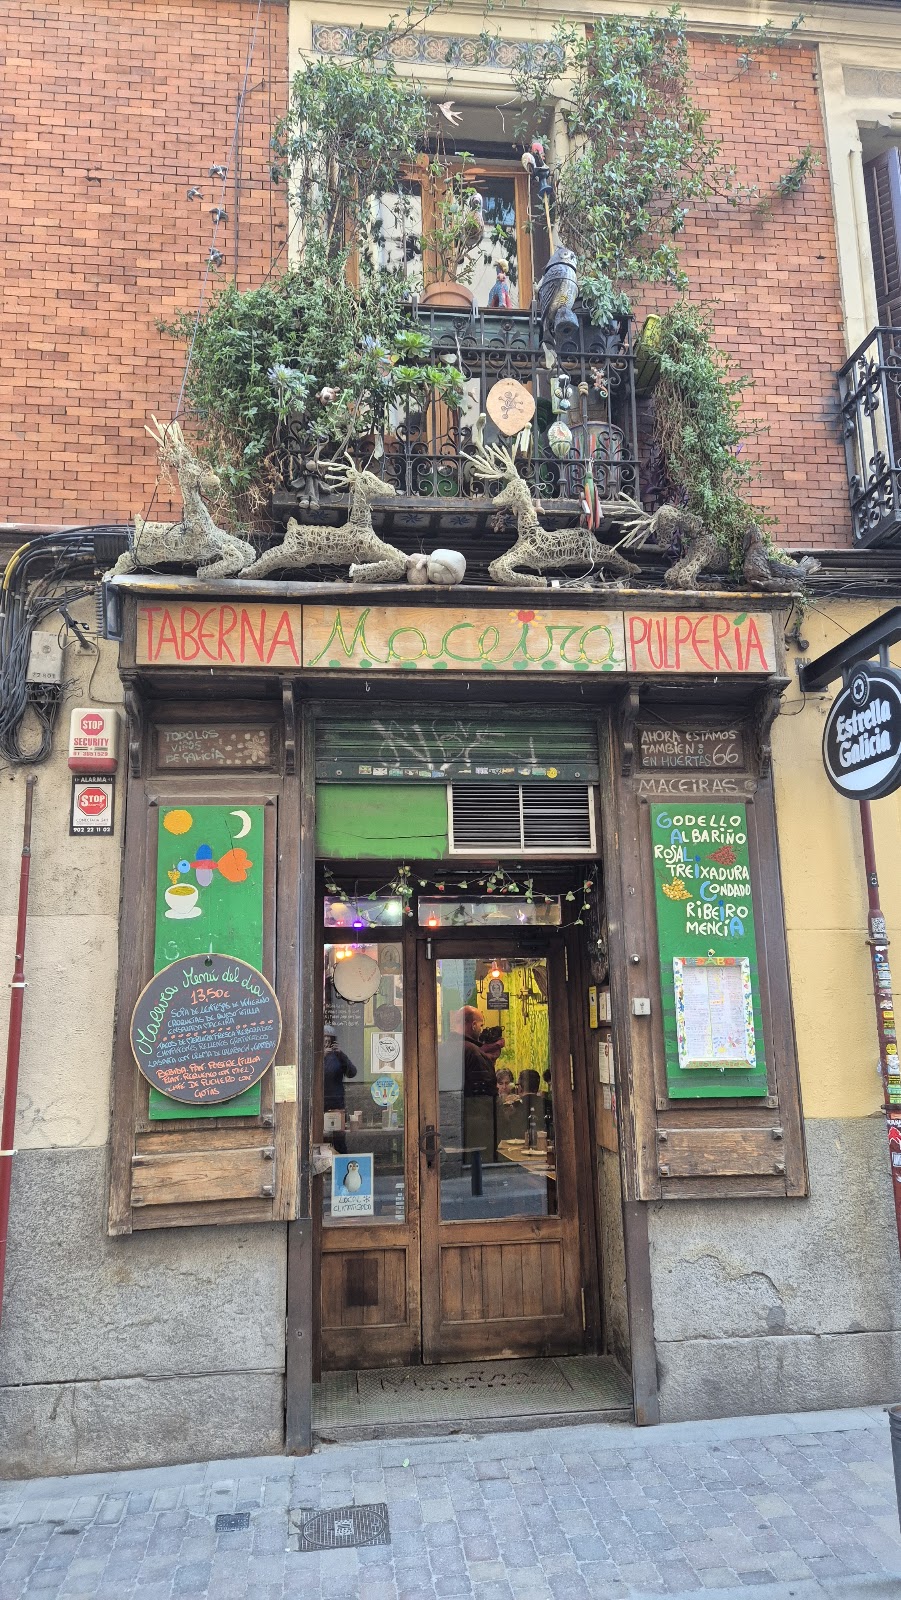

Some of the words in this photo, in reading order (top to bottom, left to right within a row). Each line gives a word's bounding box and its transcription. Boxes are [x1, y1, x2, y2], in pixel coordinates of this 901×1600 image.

[140, 604, 300, 665] TABERNA
[308, 608, 625, 664] Maceira
[628, 611, 769, 672] PULPERÍA
[82, 720, 103, 730] STOP
[836, 698, 892, 743] Estrella
[73, 737, 109, 747] SECURITY
[641, 730, 680, 744] AHORA
[685, 730, 739, 741] ESTAMOS
[642, 756, 657, 767] EN
[661, 754, 712, 767] HUERTAS
[712, 743, 739, 766] 66
[839, 727, 892, 768] Galicia
[80, 775, 107, 783] ALARMA
[639, 779, 739, 794] MACEIRAS
[81, 795, 106, 807] STOP
[656, 812, 741, 829] GODELLO
[670, 827, 747, 845] ALBARIÑO
[700, 881, 751, 901] CONDADO
[686, 900, 748, 921] RIBEIRO
[182, 966, 219, 988] Menú
[221, 965, 240, 983] del
[190, 1007, 199, 1015] DE
